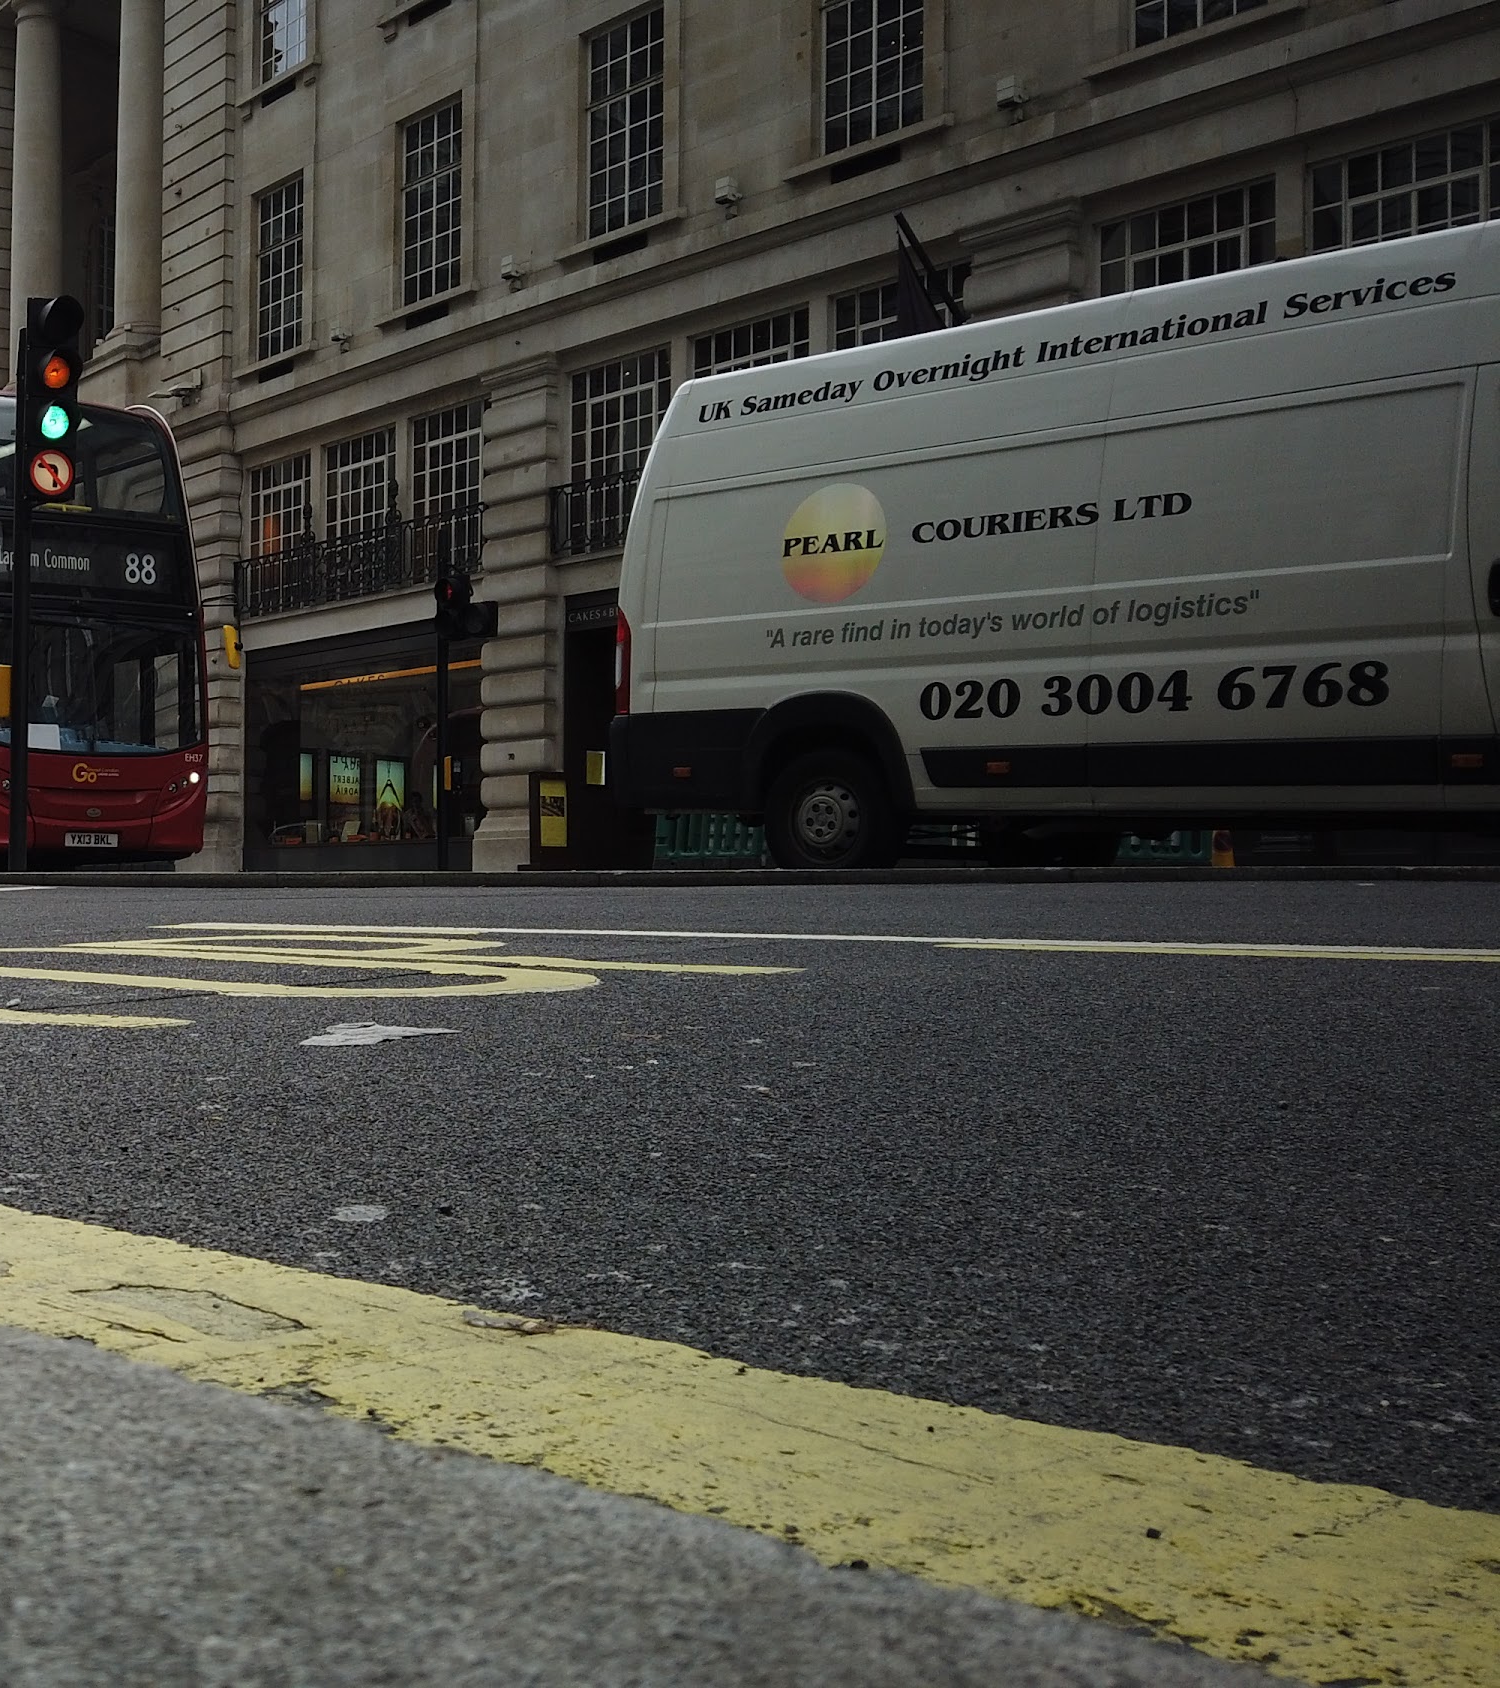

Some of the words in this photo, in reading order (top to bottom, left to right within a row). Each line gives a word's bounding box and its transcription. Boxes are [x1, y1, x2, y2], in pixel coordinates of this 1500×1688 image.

[698, 400, 733, 423] UK
[740, 379, 863, 416] Sameday
[873, 346, 1024, 391] Overnight
[1037, 301, 1268, 363] International
[1283, 272, 1456, 319] Services
[782, 529, 884, 558] PEARL
[912, 501, 1099, 543] COURIERS
[1112, 491, 1191, 522] LTD
[44, 548, 90, 571] Common
[125, 552, 157, 585] 88
[568, 610, 601, 623] CAKES
[765, 628, 786, 649] "A
[792, 628, 834, 647] rare
[841, 619, 883, 644] find
[890, 618, 911, 640] in
[918, 610, 1003, 640] today's
[1011, 604, 1084, 631] world
[1093, 601, 1119, 625] of
[1127, 590, 1260, 626] logistics"
[919, 678, 1021, 721] 020
[1041, 669, 1193, 716] 3004
[1217, 660, 1389, 711] 6768
[184, 752, 203, 763] EH37
[72, 762, 97, 783] Go
[71, 834, 92, 845] YX13
[94, 835, 112, 845] BKL
